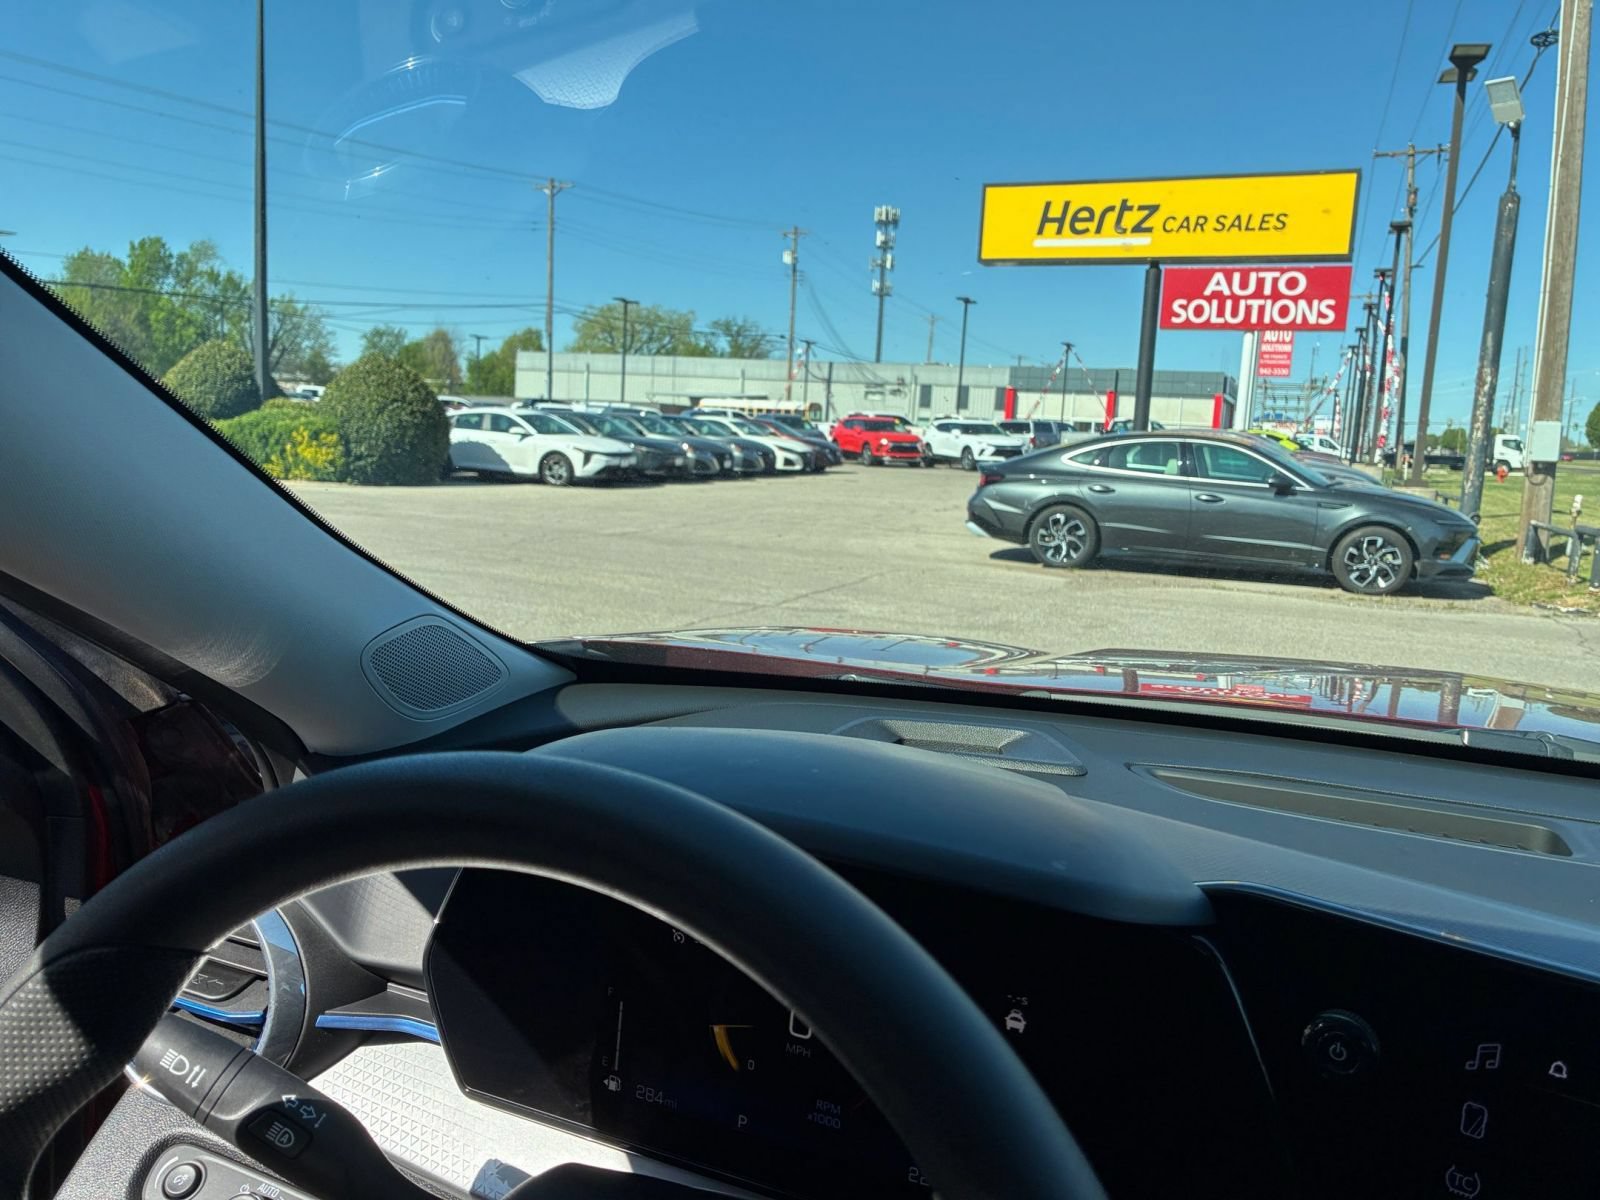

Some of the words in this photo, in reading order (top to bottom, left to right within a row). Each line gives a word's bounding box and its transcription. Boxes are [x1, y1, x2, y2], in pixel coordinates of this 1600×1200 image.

[1037, 198, 1160, 235] Hertz
[1162, 215, 1208, 233] CAR
[1213, 213, 1288, 233] SALES
[1203, 271, 1307, 297] AUTO
[1171, 298, 1336, 325] SOLUTIONS
[784, 1042, 812, 1059] MPH
[601, 1055, 609, 1067] E
[747, 1058, 756, 1071] 0
[815, 1099, 841, 1116] RPM
[737, 1114, 748, 1129] P
[1452, 1171, 1474, 1191] TC
[257, 1183, 280, 1198] AUTO
